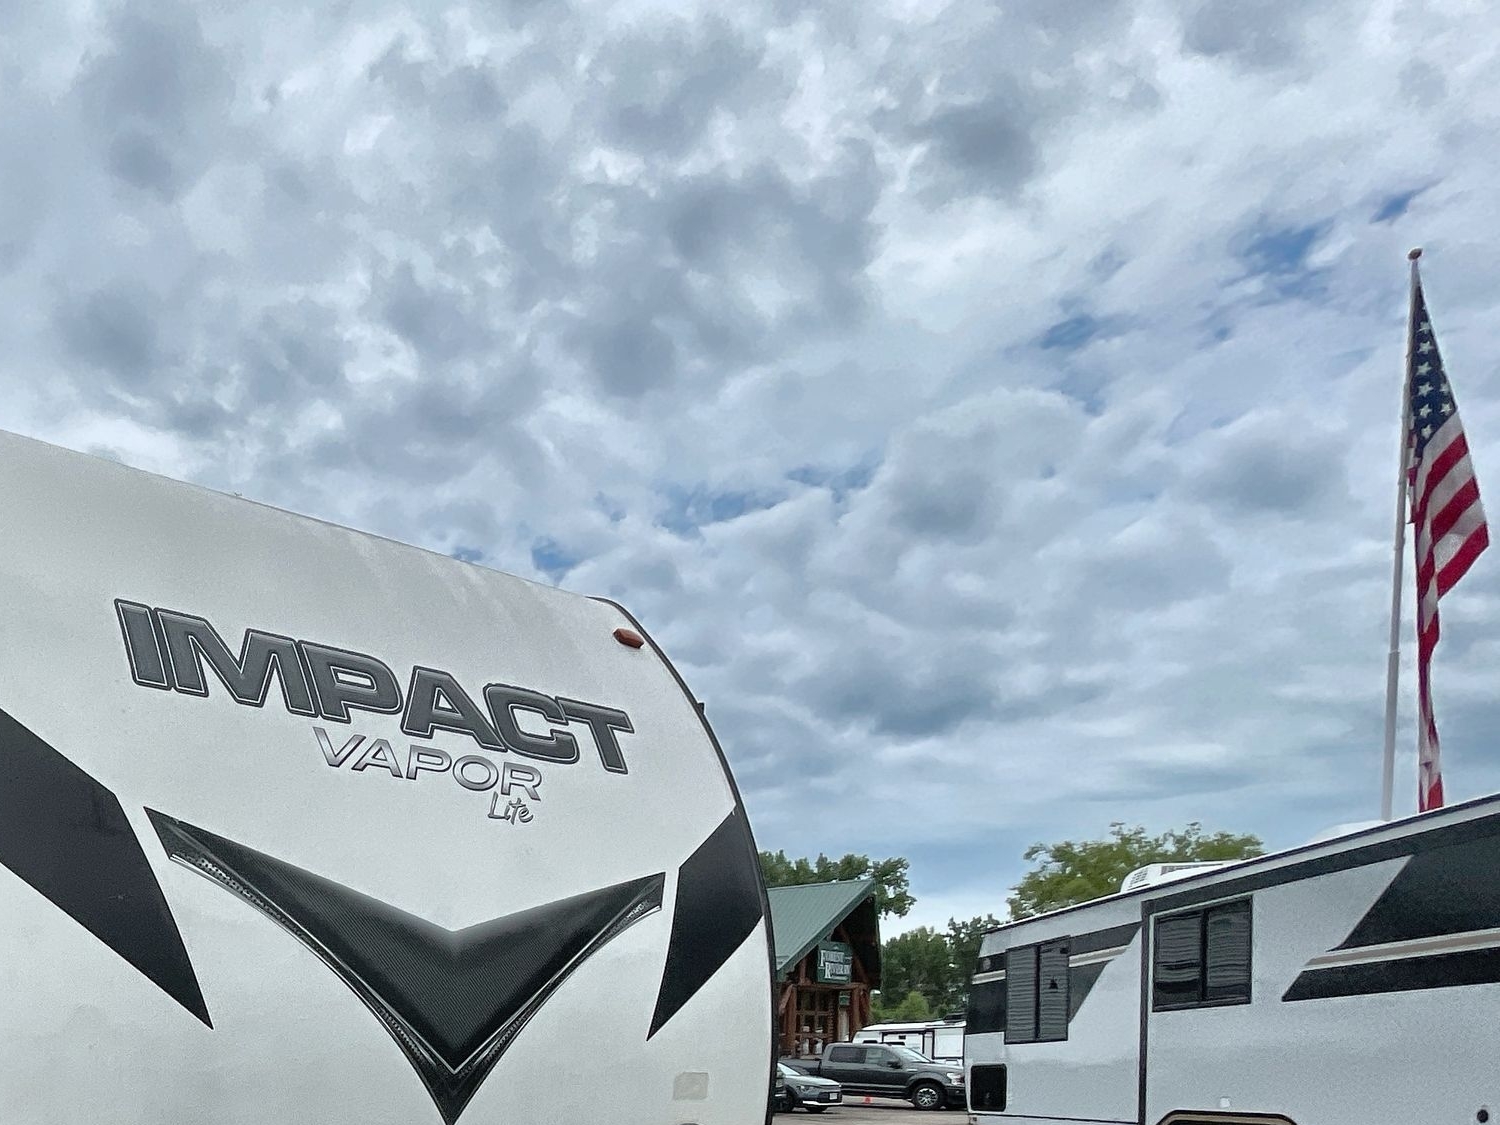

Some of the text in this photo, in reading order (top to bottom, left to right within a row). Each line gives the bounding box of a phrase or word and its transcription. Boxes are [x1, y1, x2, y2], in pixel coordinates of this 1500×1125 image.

[113, 598, 634, 775] IMPACT
[312, 726, 542, 802] VAPOR
[487, 791, 534, 826] Lite
